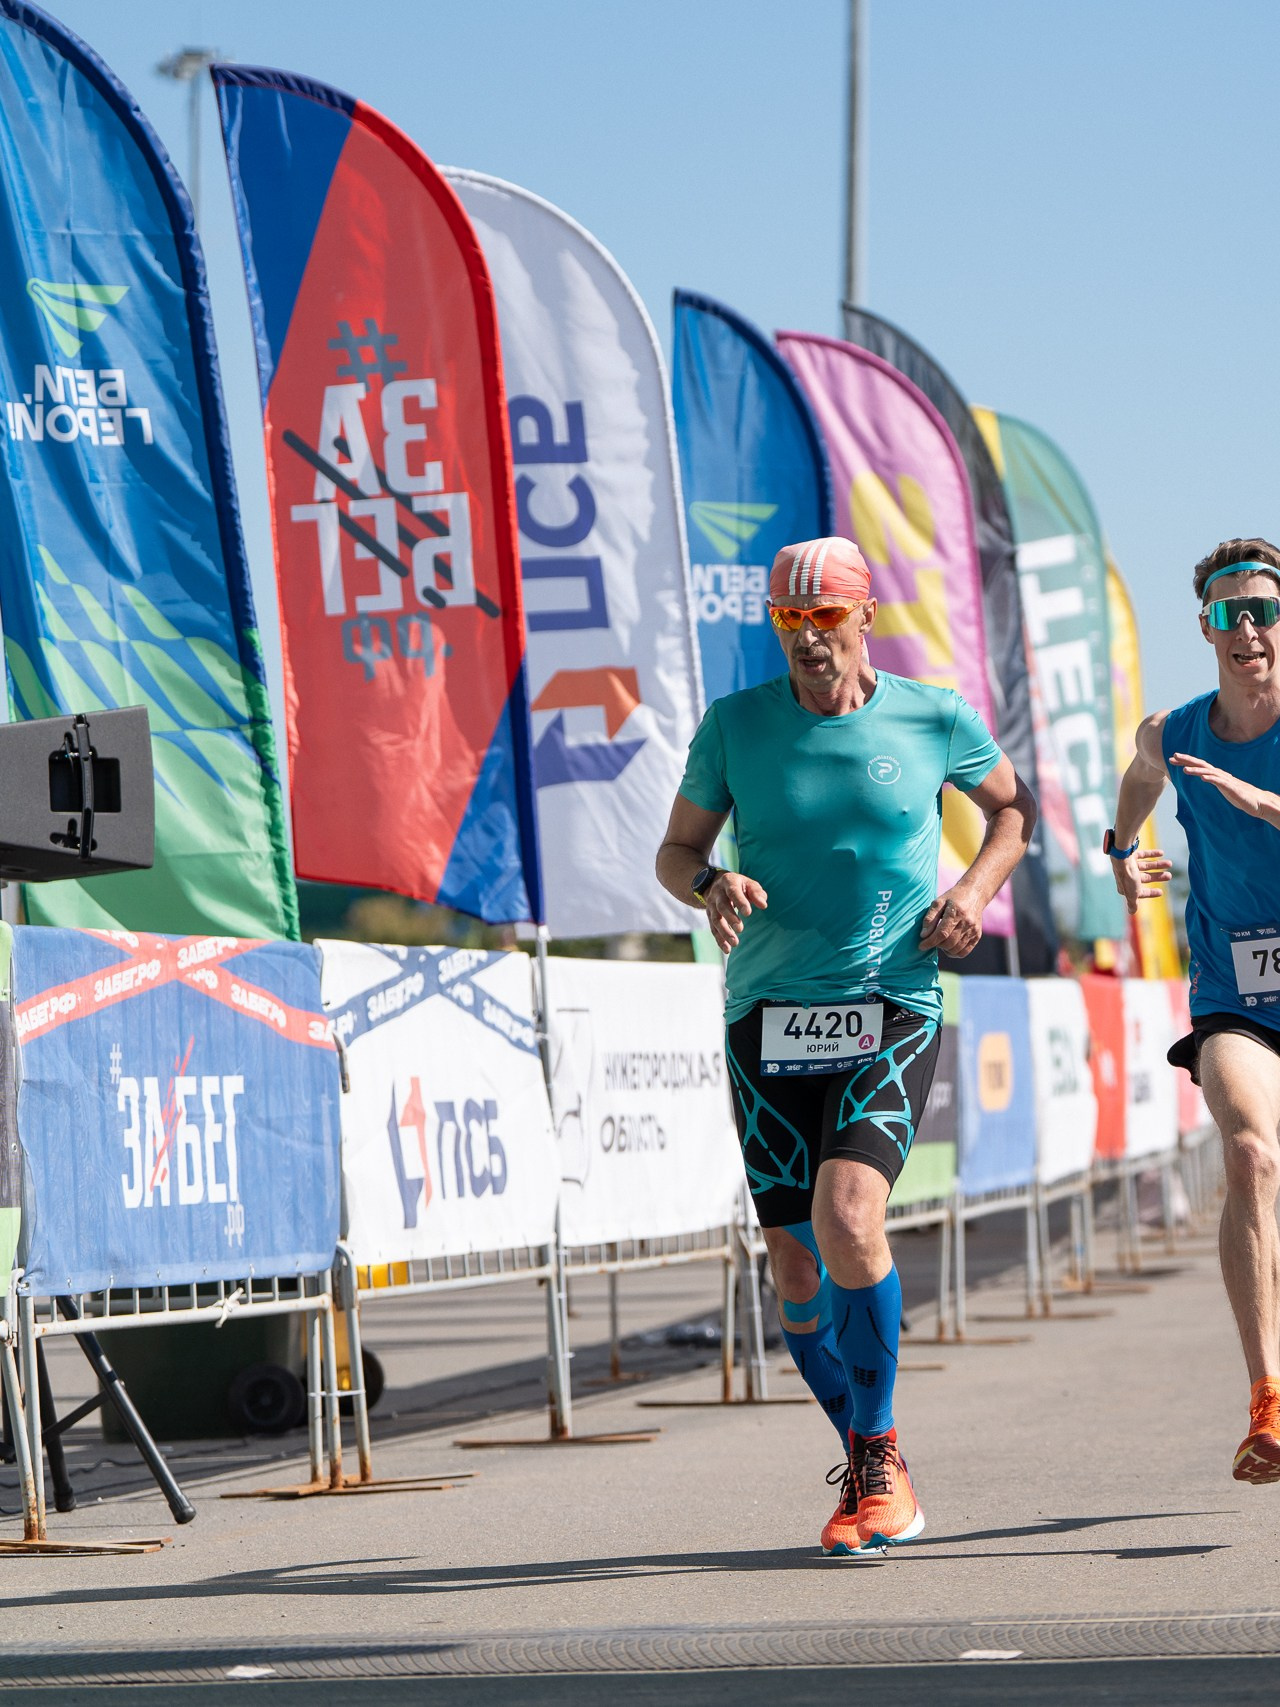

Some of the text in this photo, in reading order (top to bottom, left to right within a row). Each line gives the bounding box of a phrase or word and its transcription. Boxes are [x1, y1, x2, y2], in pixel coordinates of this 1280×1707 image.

[94, 959, 161, 1002] ЗАБЕГ.РФ
[783, 1010, 863, 1039] 4420
[806, 1042, 839, 1053] ЮРИЙ
[116, 1075, 245, 1209] ЗАБЕГ
[433, 1098, 508, 1200] ПСБ
